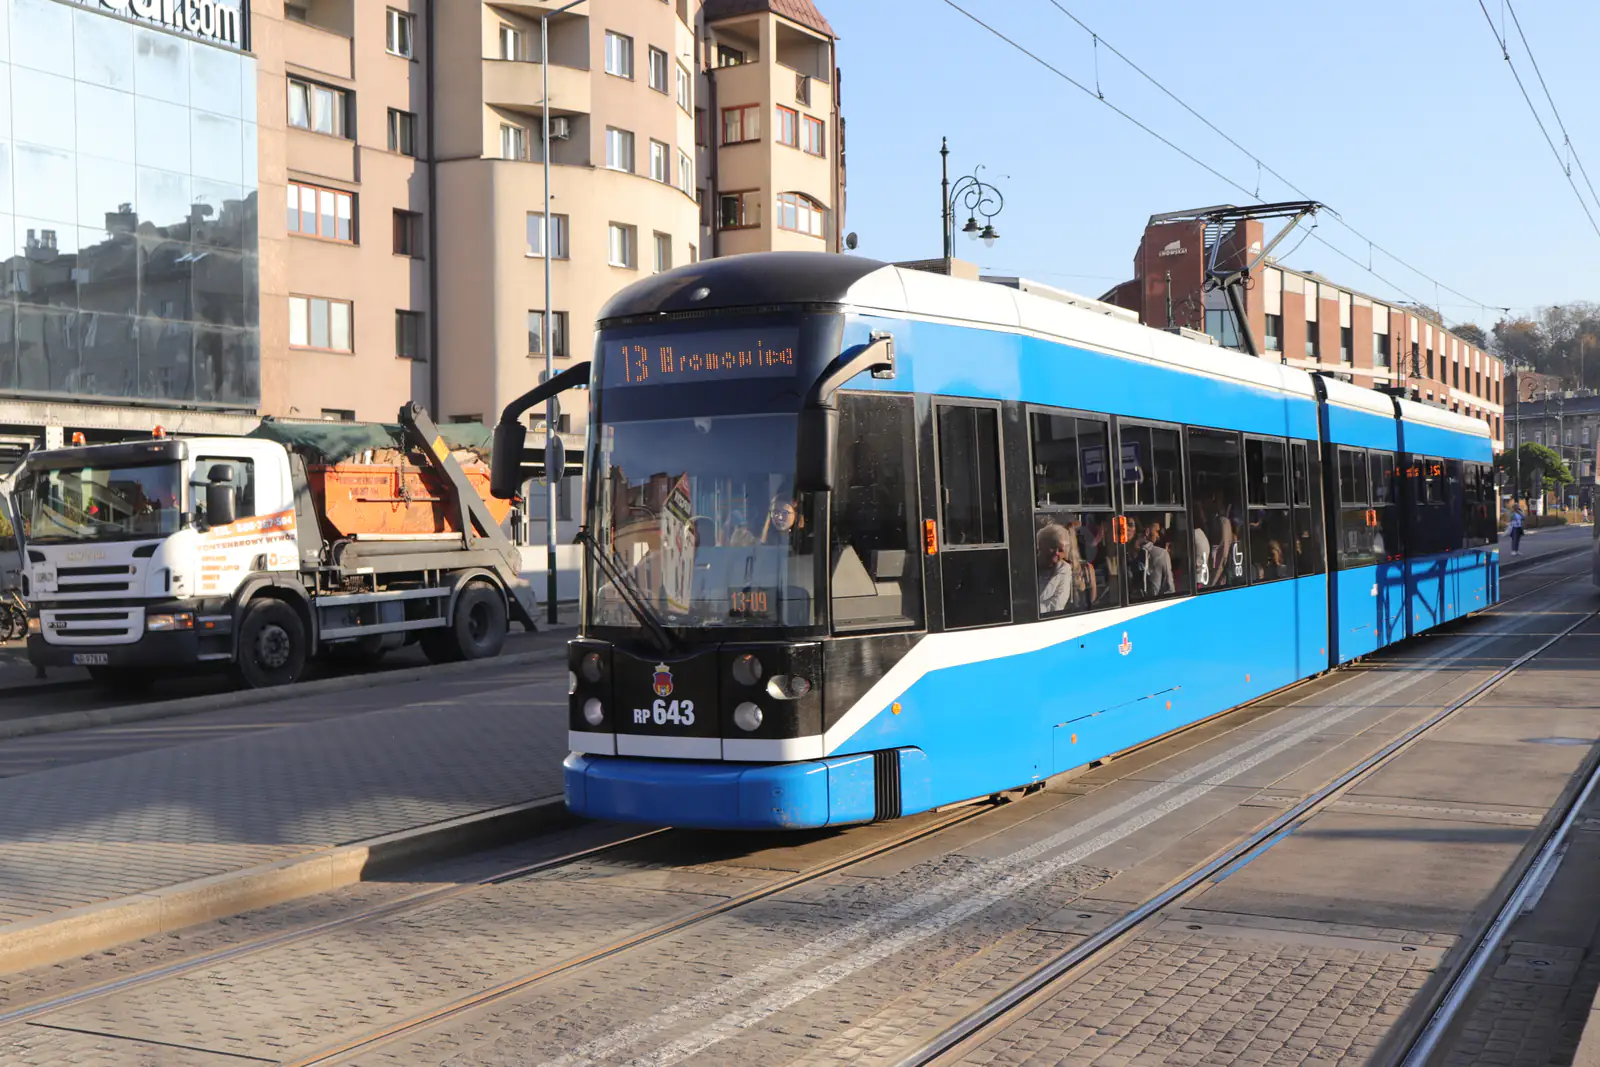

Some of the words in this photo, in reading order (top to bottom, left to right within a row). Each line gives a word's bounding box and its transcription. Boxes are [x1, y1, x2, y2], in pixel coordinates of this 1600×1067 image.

[621, 345, 649, 383] 13
[633, 708, 651, 724] RP
[653, 699, 696, 726] 643
